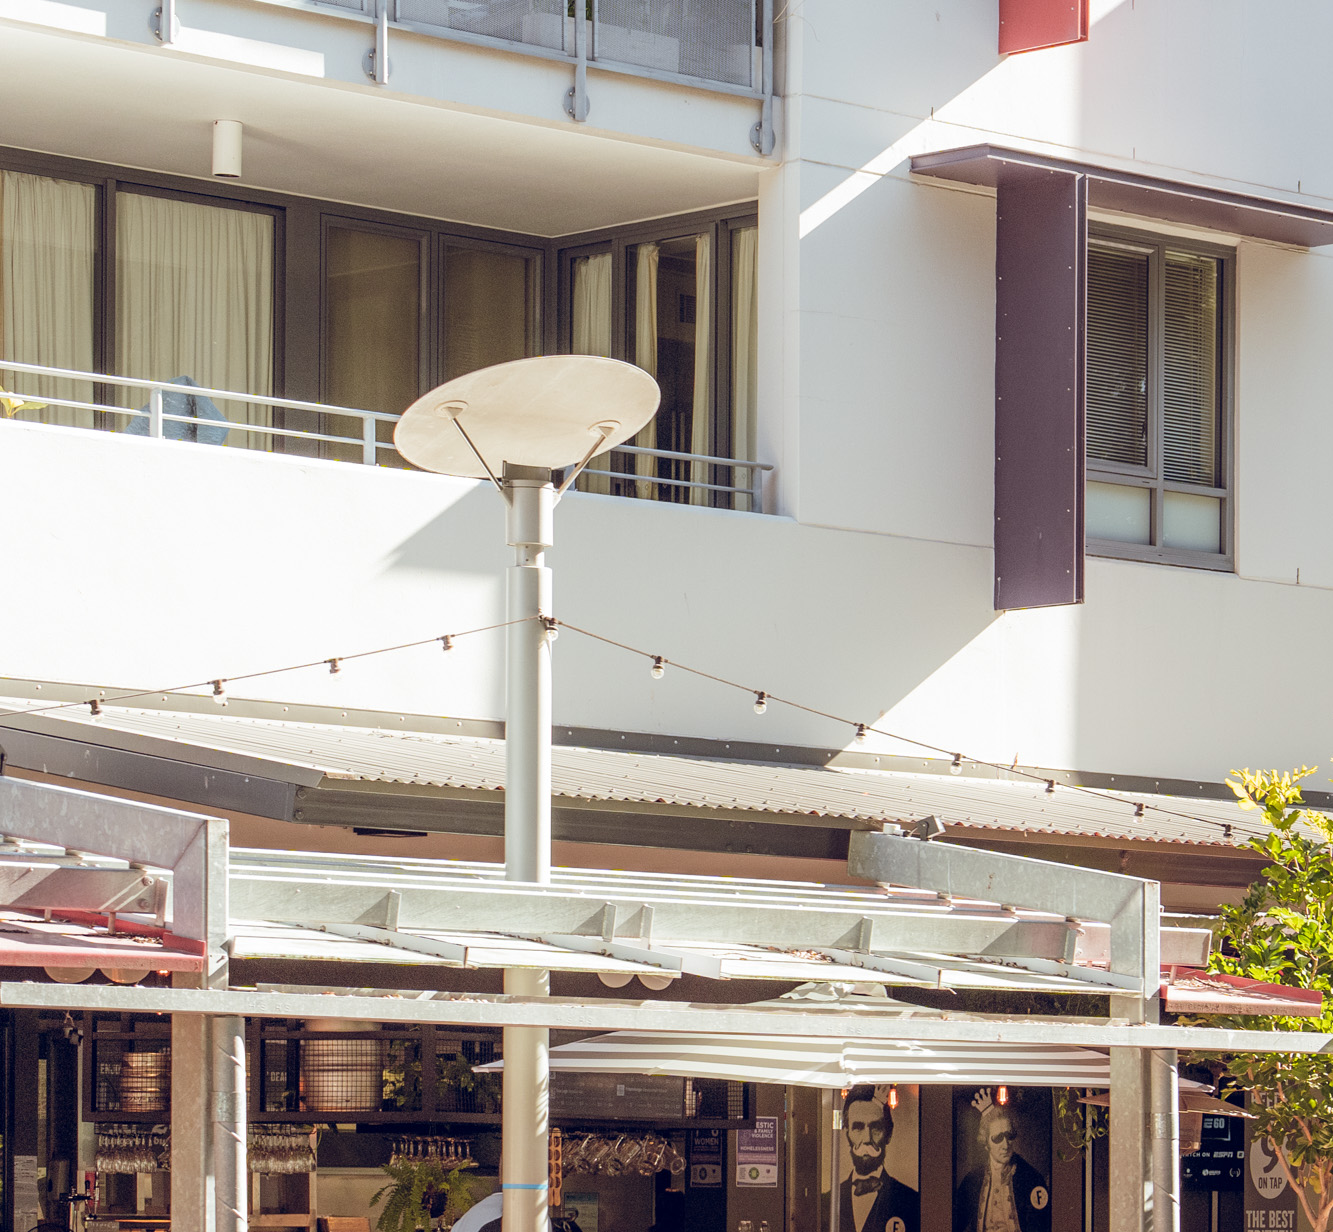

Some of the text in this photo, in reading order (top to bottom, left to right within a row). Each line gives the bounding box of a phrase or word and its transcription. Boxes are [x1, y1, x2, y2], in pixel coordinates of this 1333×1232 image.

[756, 1121, 774, 1129] ESTIC
[1258, 1177, 1283, 1189] ON TAP
[1036, 1190, 1042, 1206] F
[1246, 1210, 1295, 1229] THE BEST
